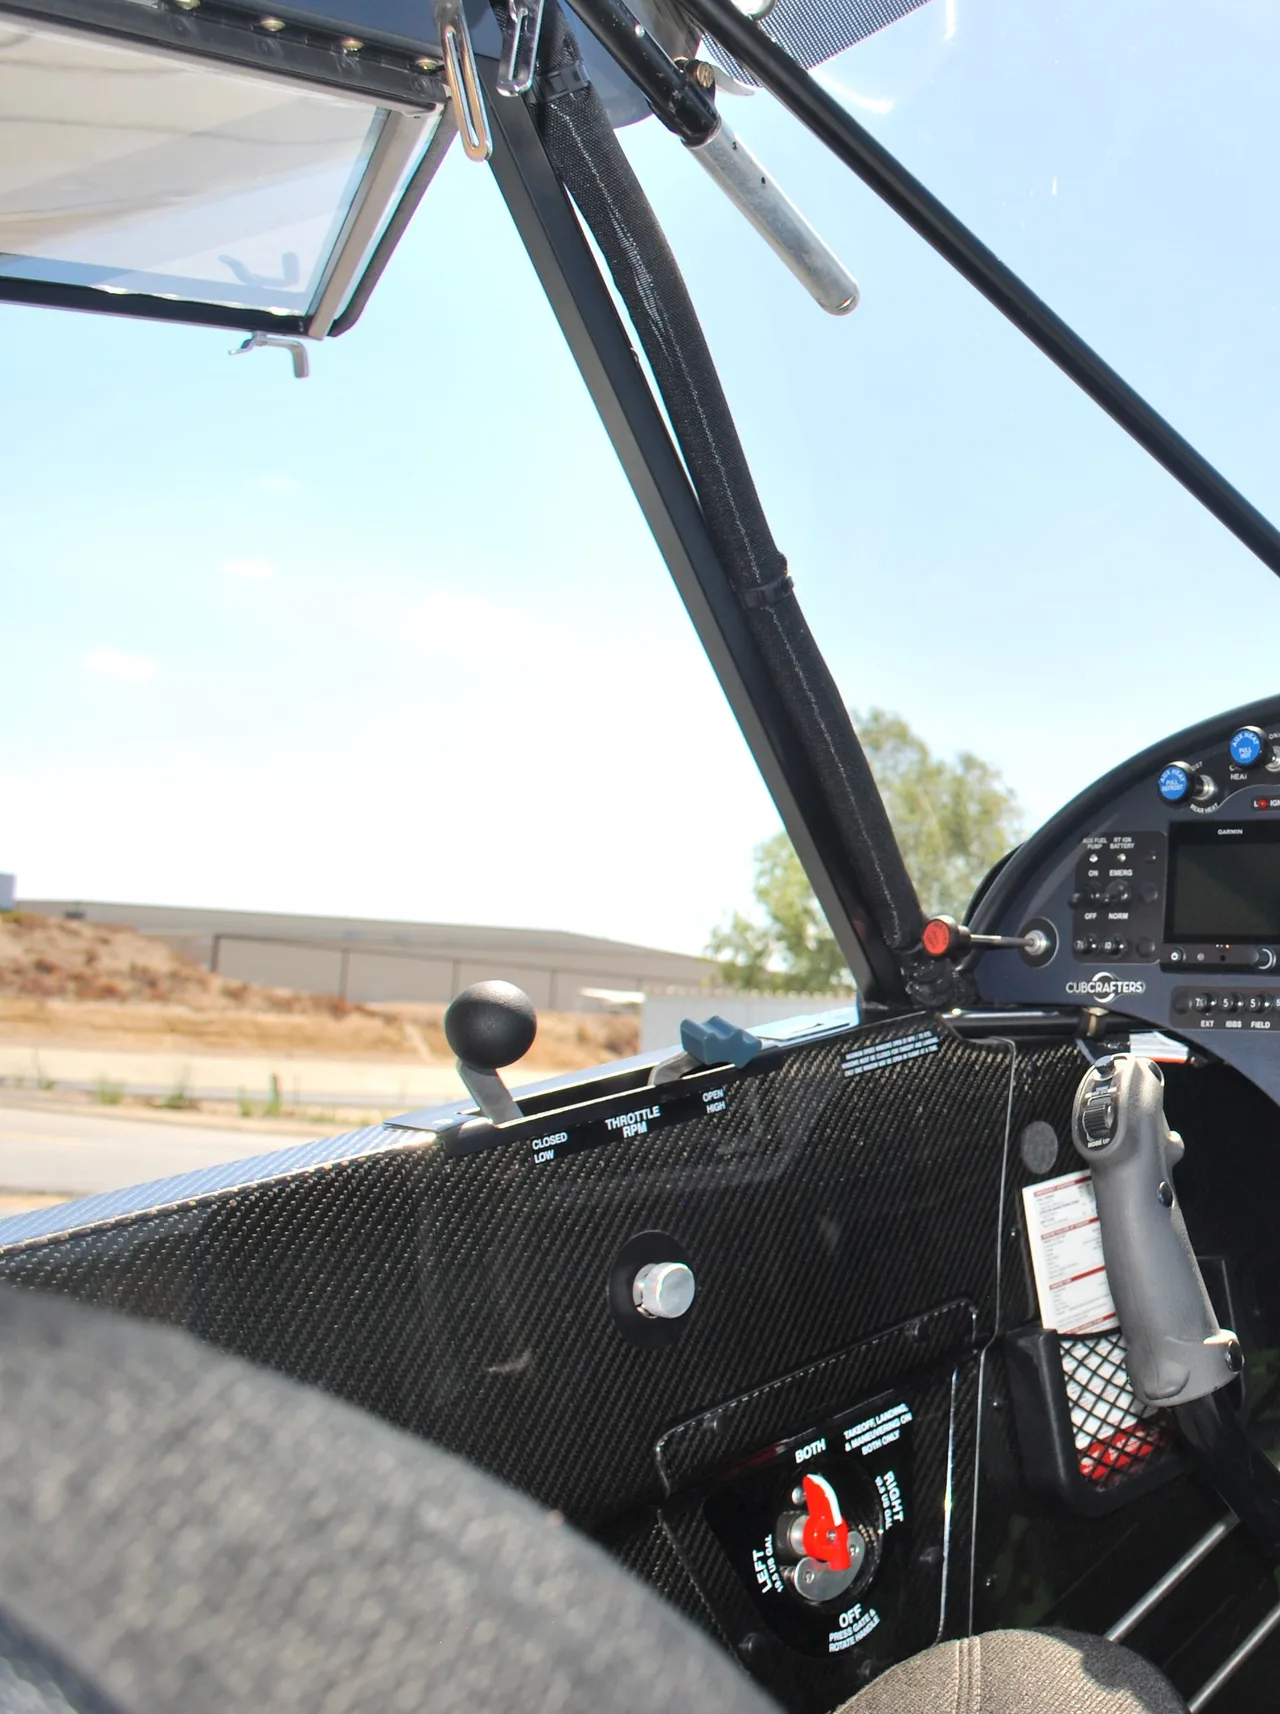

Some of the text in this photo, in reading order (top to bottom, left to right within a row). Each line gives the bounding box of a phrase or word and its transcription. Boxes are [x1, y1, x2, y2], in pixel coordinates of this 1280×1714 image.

[1066, 981, 1143, 993] CUBCRAFTERS
[1223, 999, 1228, 1007] 5
[1250, 999, 1255, 1007] 5
[703, 1089, 724, 1102] OPEN
[706, 1101, 726, 1114] HIGH
[605, 1106, 660, 1130] THROTTLE
[622, 1121, 647, 1138] RPM
[533, 1133, 567, 1150] CLOSED
[534, 1150, 554, 1163] LOW
[862, 1429, 900, 1455] BOTH ONLY
[795, 1438, 827, 1464] BOTH
[883, 1470, 904, 1522] RIGHT
[764, 1534, 773, 1556] GAL
[752, 1550, 772, 1593] LEFT
[839, 1603, 862, 1628] OFF
